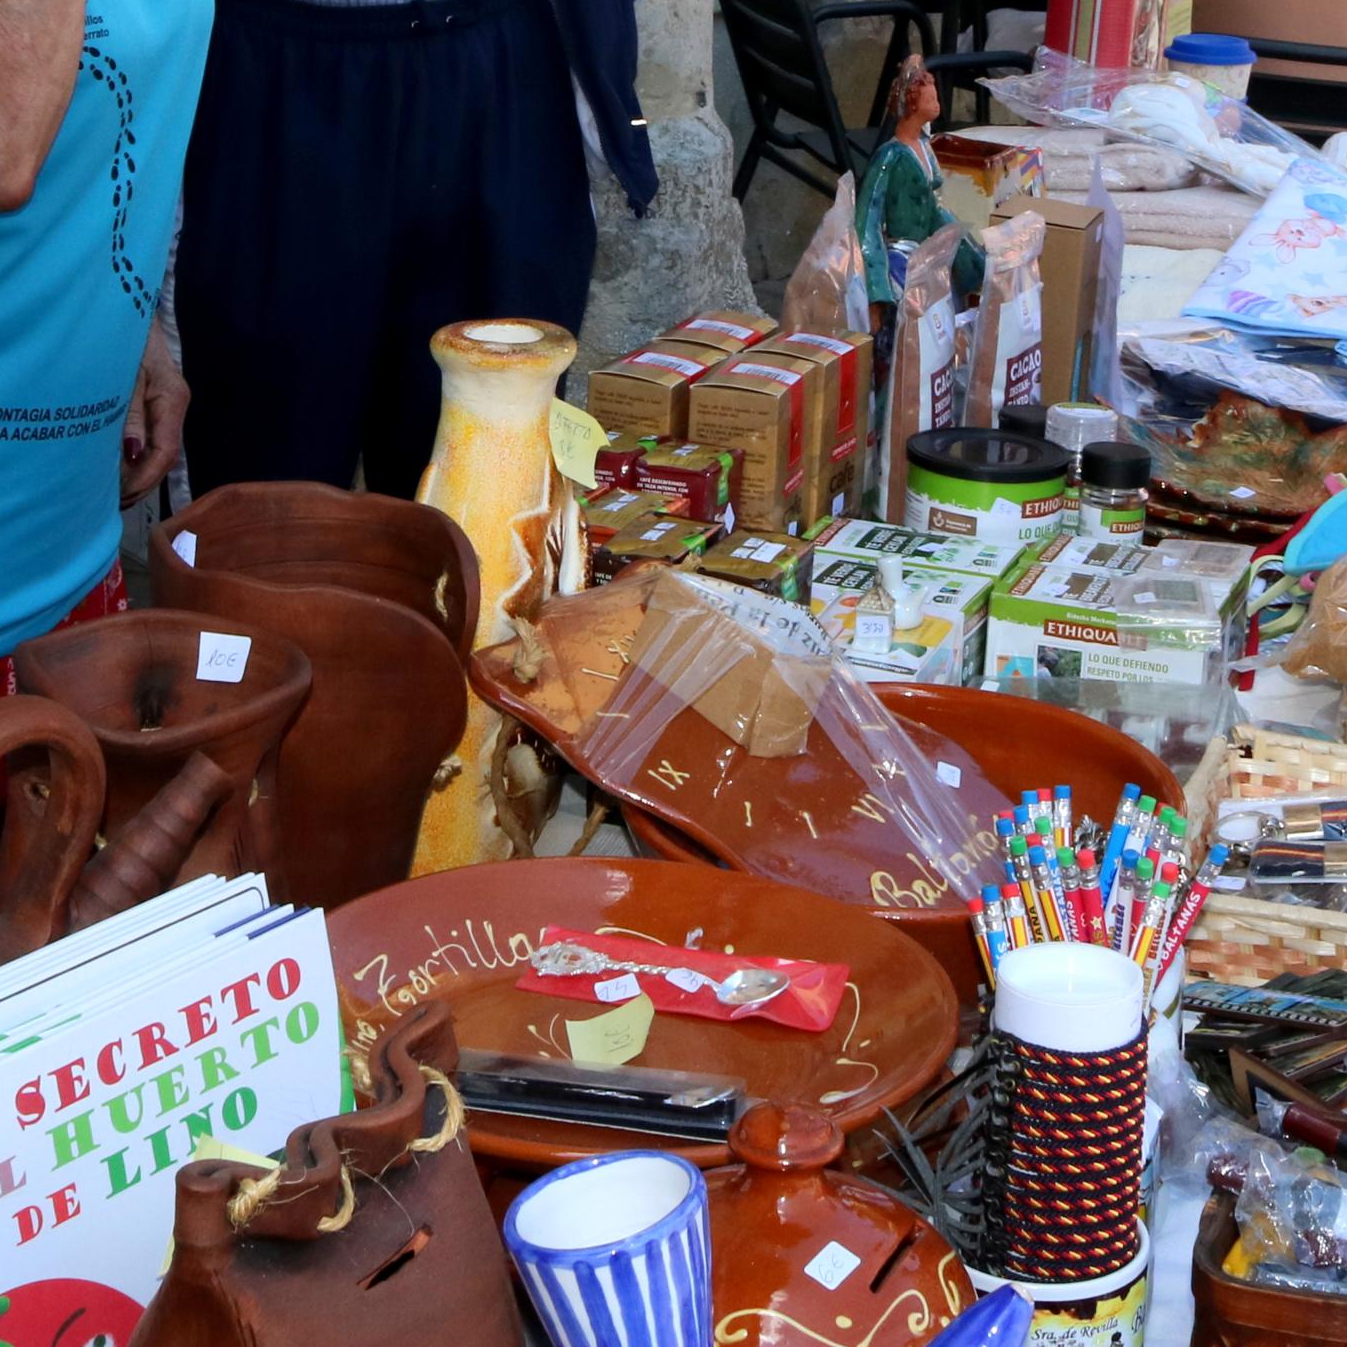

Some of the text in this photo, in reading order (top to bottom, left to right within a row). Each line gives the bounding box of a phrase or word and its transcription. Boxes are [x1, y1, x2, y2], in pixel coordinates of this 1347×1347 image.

[1010, 349, 1042, 381] CACAO
[11, 426, 64, 441] ACABAR
[67, 422, 90, 439] CON
[1087, 665, 1120, 679] RESPETO
[1089, 653, 1169, 673] LO QUE DEFIENDO
[15, 957, 303, 1130] SECRETO
[45, 1000, 320, 1171] HUERTO
[12, 1086, 258, 1247] DE LINO
[1031, 1316, 1119, 1342] Sra. de Revilla
